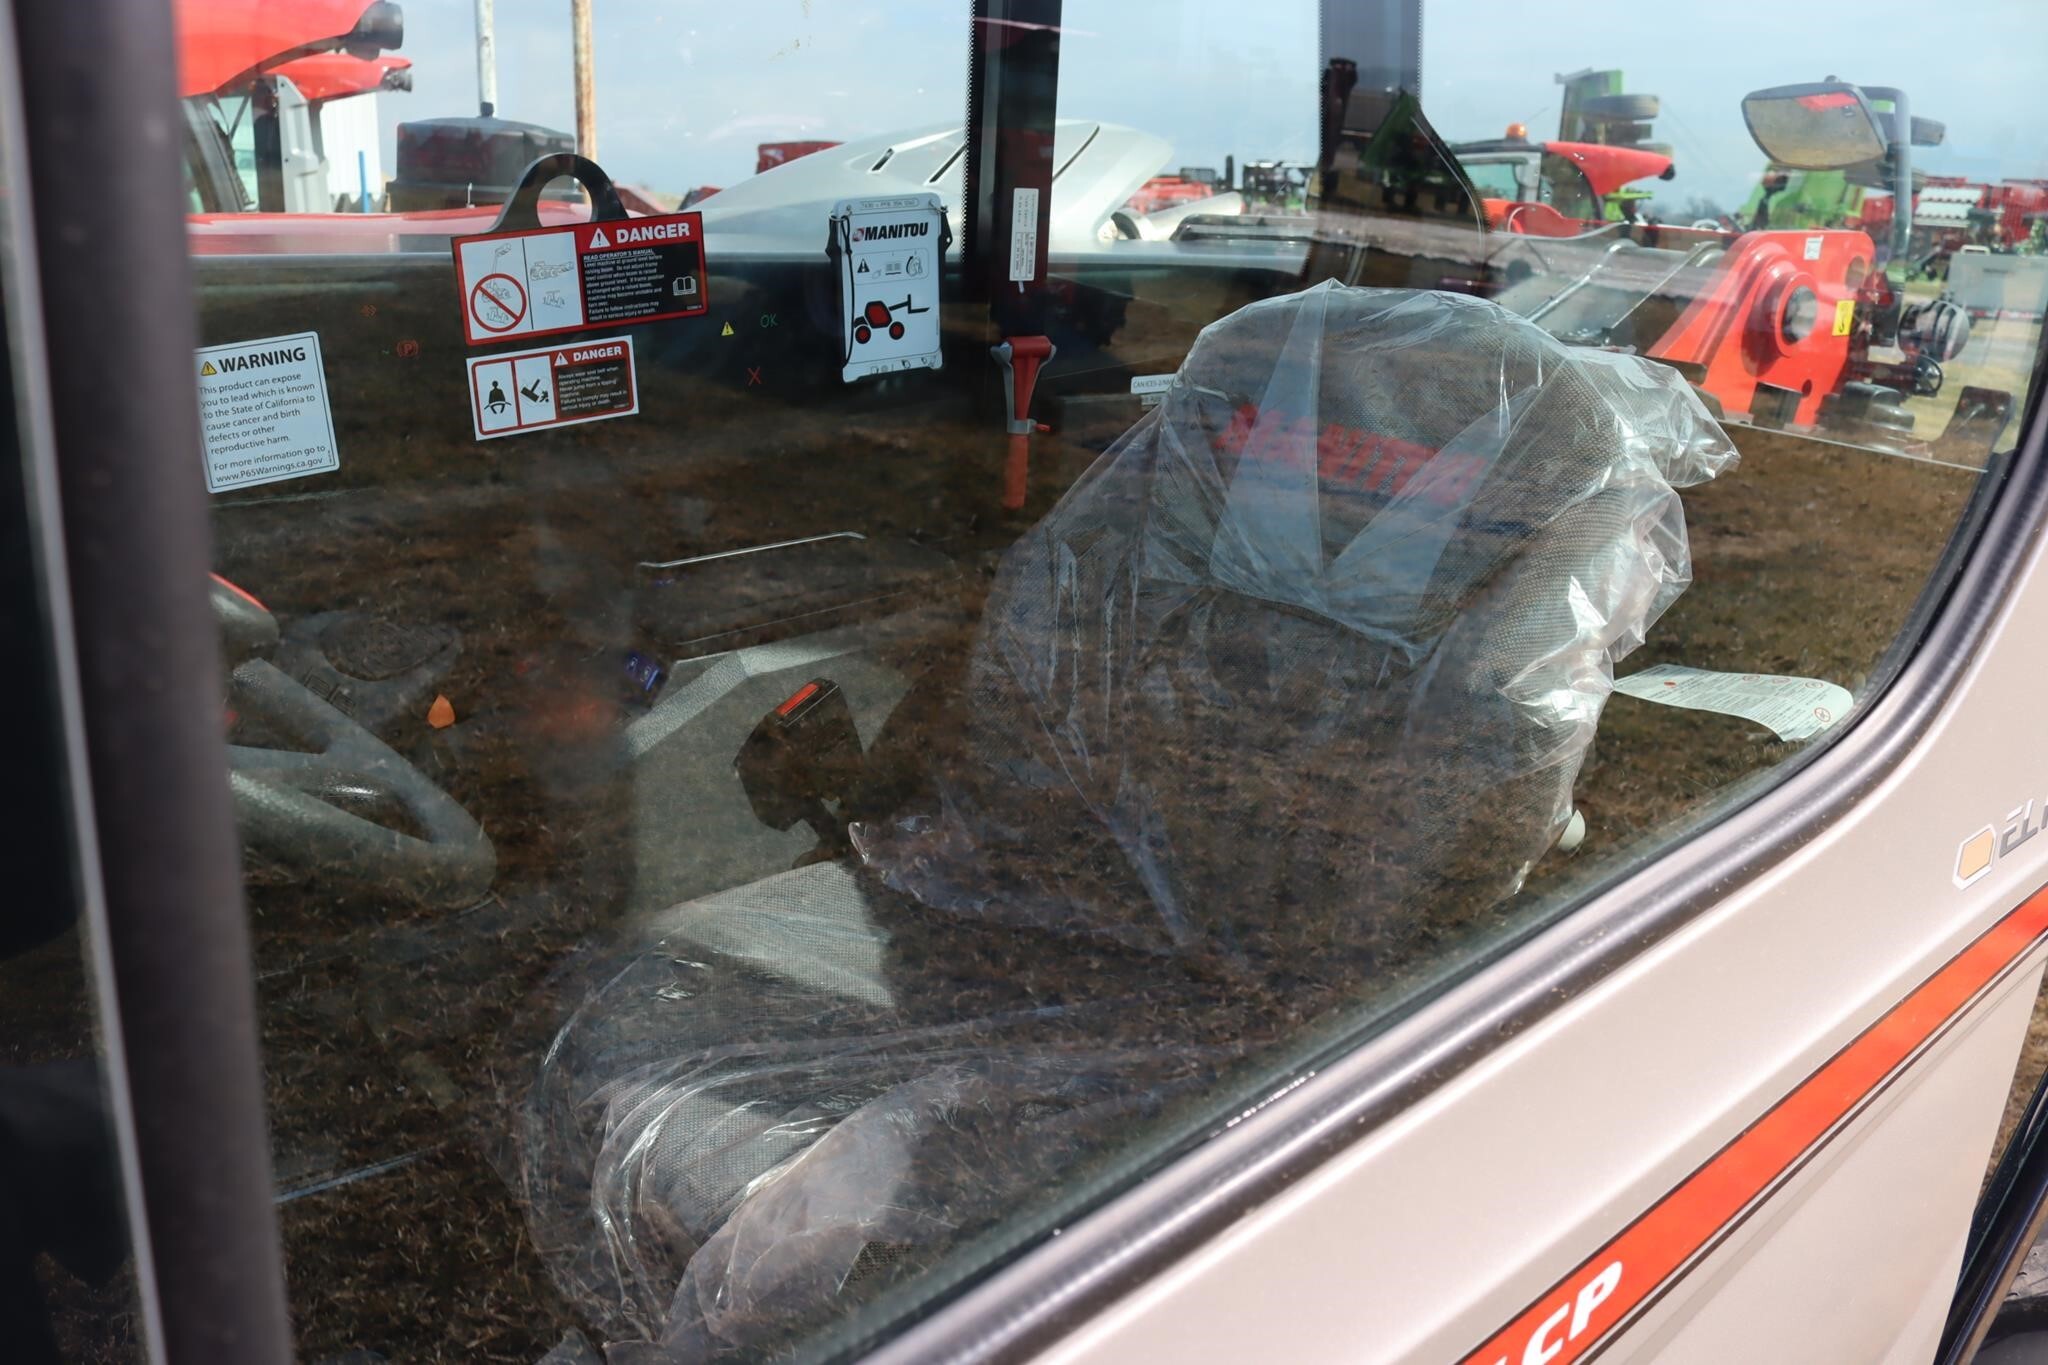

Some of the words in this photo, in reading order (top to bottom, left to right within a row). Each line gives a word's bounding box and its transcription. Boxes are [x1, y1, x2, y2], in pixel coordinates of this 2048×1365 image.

[616, 222, 690, 244] DANGER
[865, 222, 929, 241] MANITOU
[760, 313, 779, 328] OK
[219, 347, 306, 373] WARNING
[573, 346, 622, 362] DANGER
[219, 381, 253, 394] product
[254, 378, 270, 386] can
[271, 372, 302, 384] expose
[200, 399, 218, 410] you
[220, 396, 230, 405] to
[231, 393, 249, 404] lead
[250, 388, 277, 400] which
[278, 386, 286, 395] is
[286, 383, 316, 394] known
[203, 410, 214, 420] to
[215, 407, 230, 418] the
[231, 404, 254, 415] State
[254, 400, 264, 410] of
[264, 397, 306, 410] California
[306, 394, 316, 402] to
[206, 420, 232, 432] cause
[232, 416, 261, 427] cancer
[262, 412, 279, 422] and
[280, 408, 301, 419] birth
[208, 432, 240, 444] defects
[241, 429, 252, 438] or
[252, 424, 276, 436] other
[210, 438, 266, 456] reproductive
[266, 435, 291, 445] harm.
[213, 462, 228, 471] For
[230, 458, 253, 468] more
[254, 449, 303, 464] information
[304, 447, 316, 456] go
[316, 444, 326, 453] to
[216, 457, 324, 483] www.P65Warnings.ca.gov
[1494, 1261, 1622, 1365] CP
